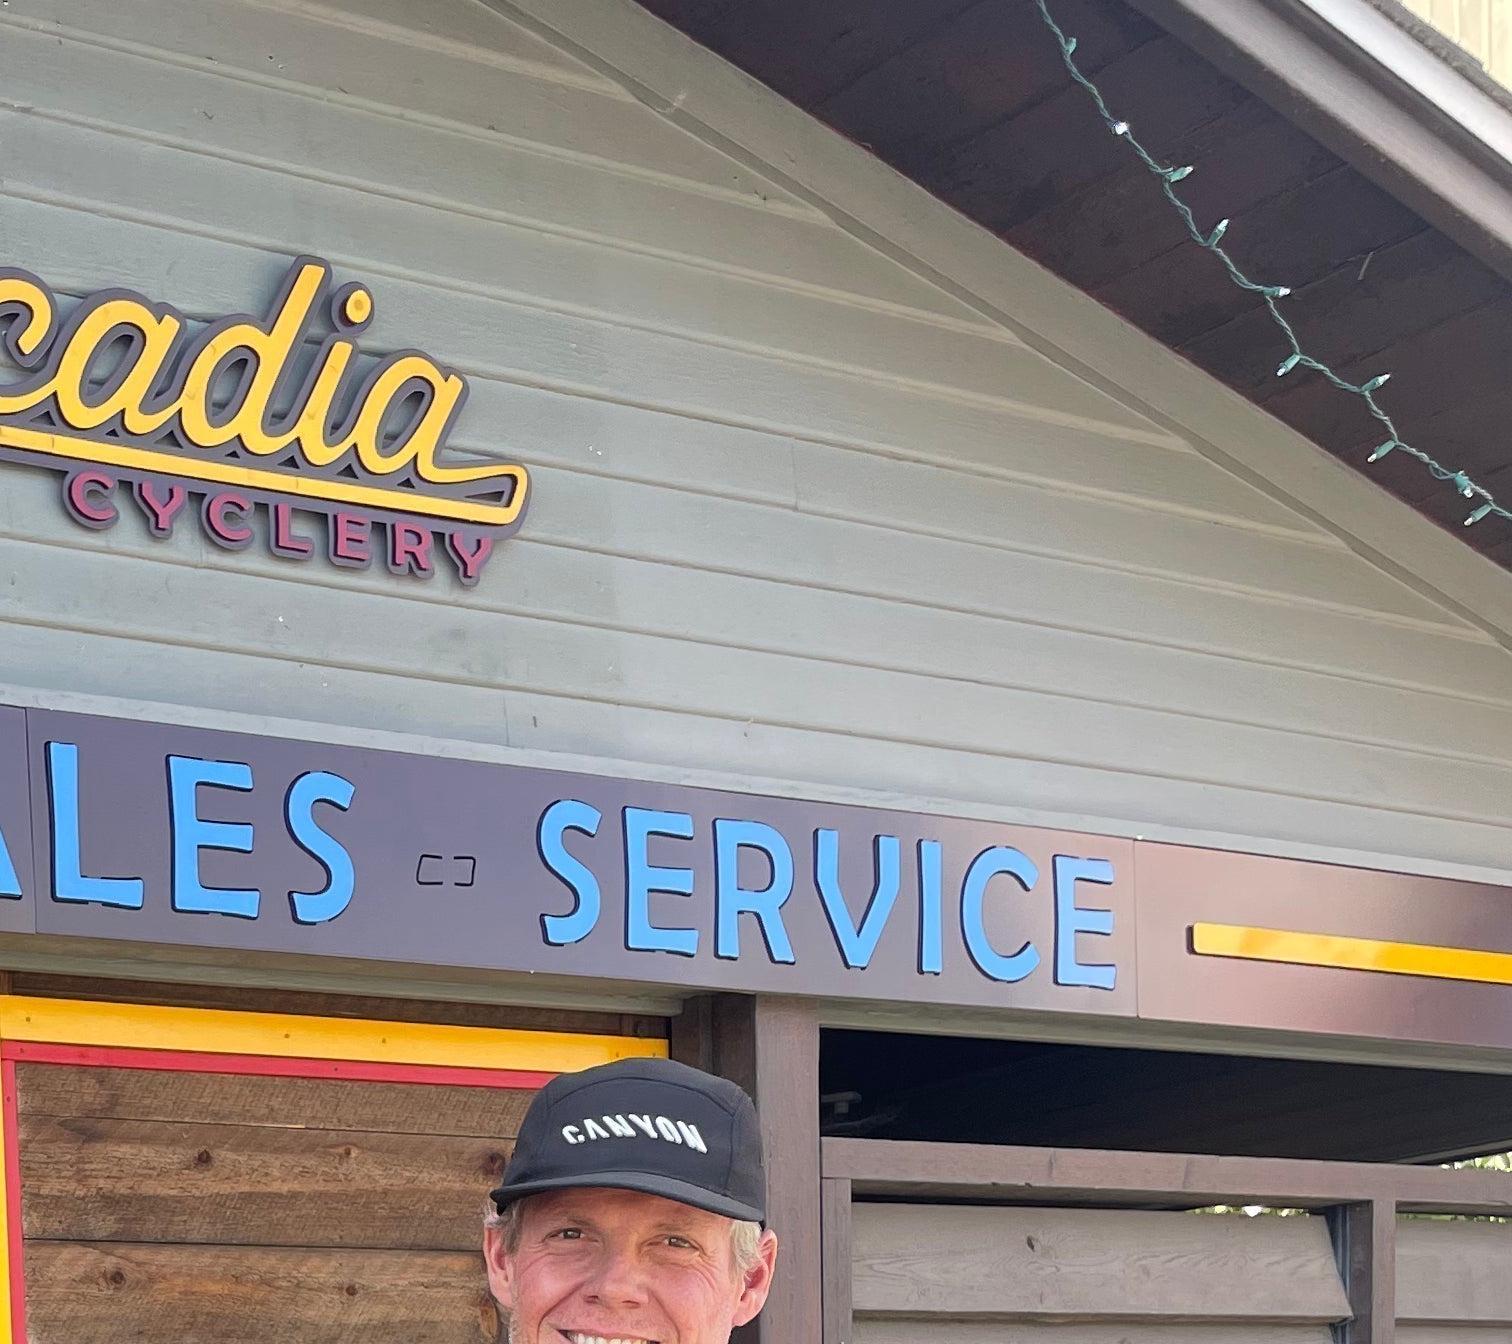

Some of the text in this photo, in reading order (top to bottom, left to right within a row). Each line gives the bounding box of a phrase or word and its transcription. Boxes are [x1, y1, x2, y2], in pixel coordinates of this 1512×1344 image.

[69, 470, 491, 580] CYCLERY
[537, 799, 1118, 988] SERVICE
[562, 1113, 708, 1154] CANYON
